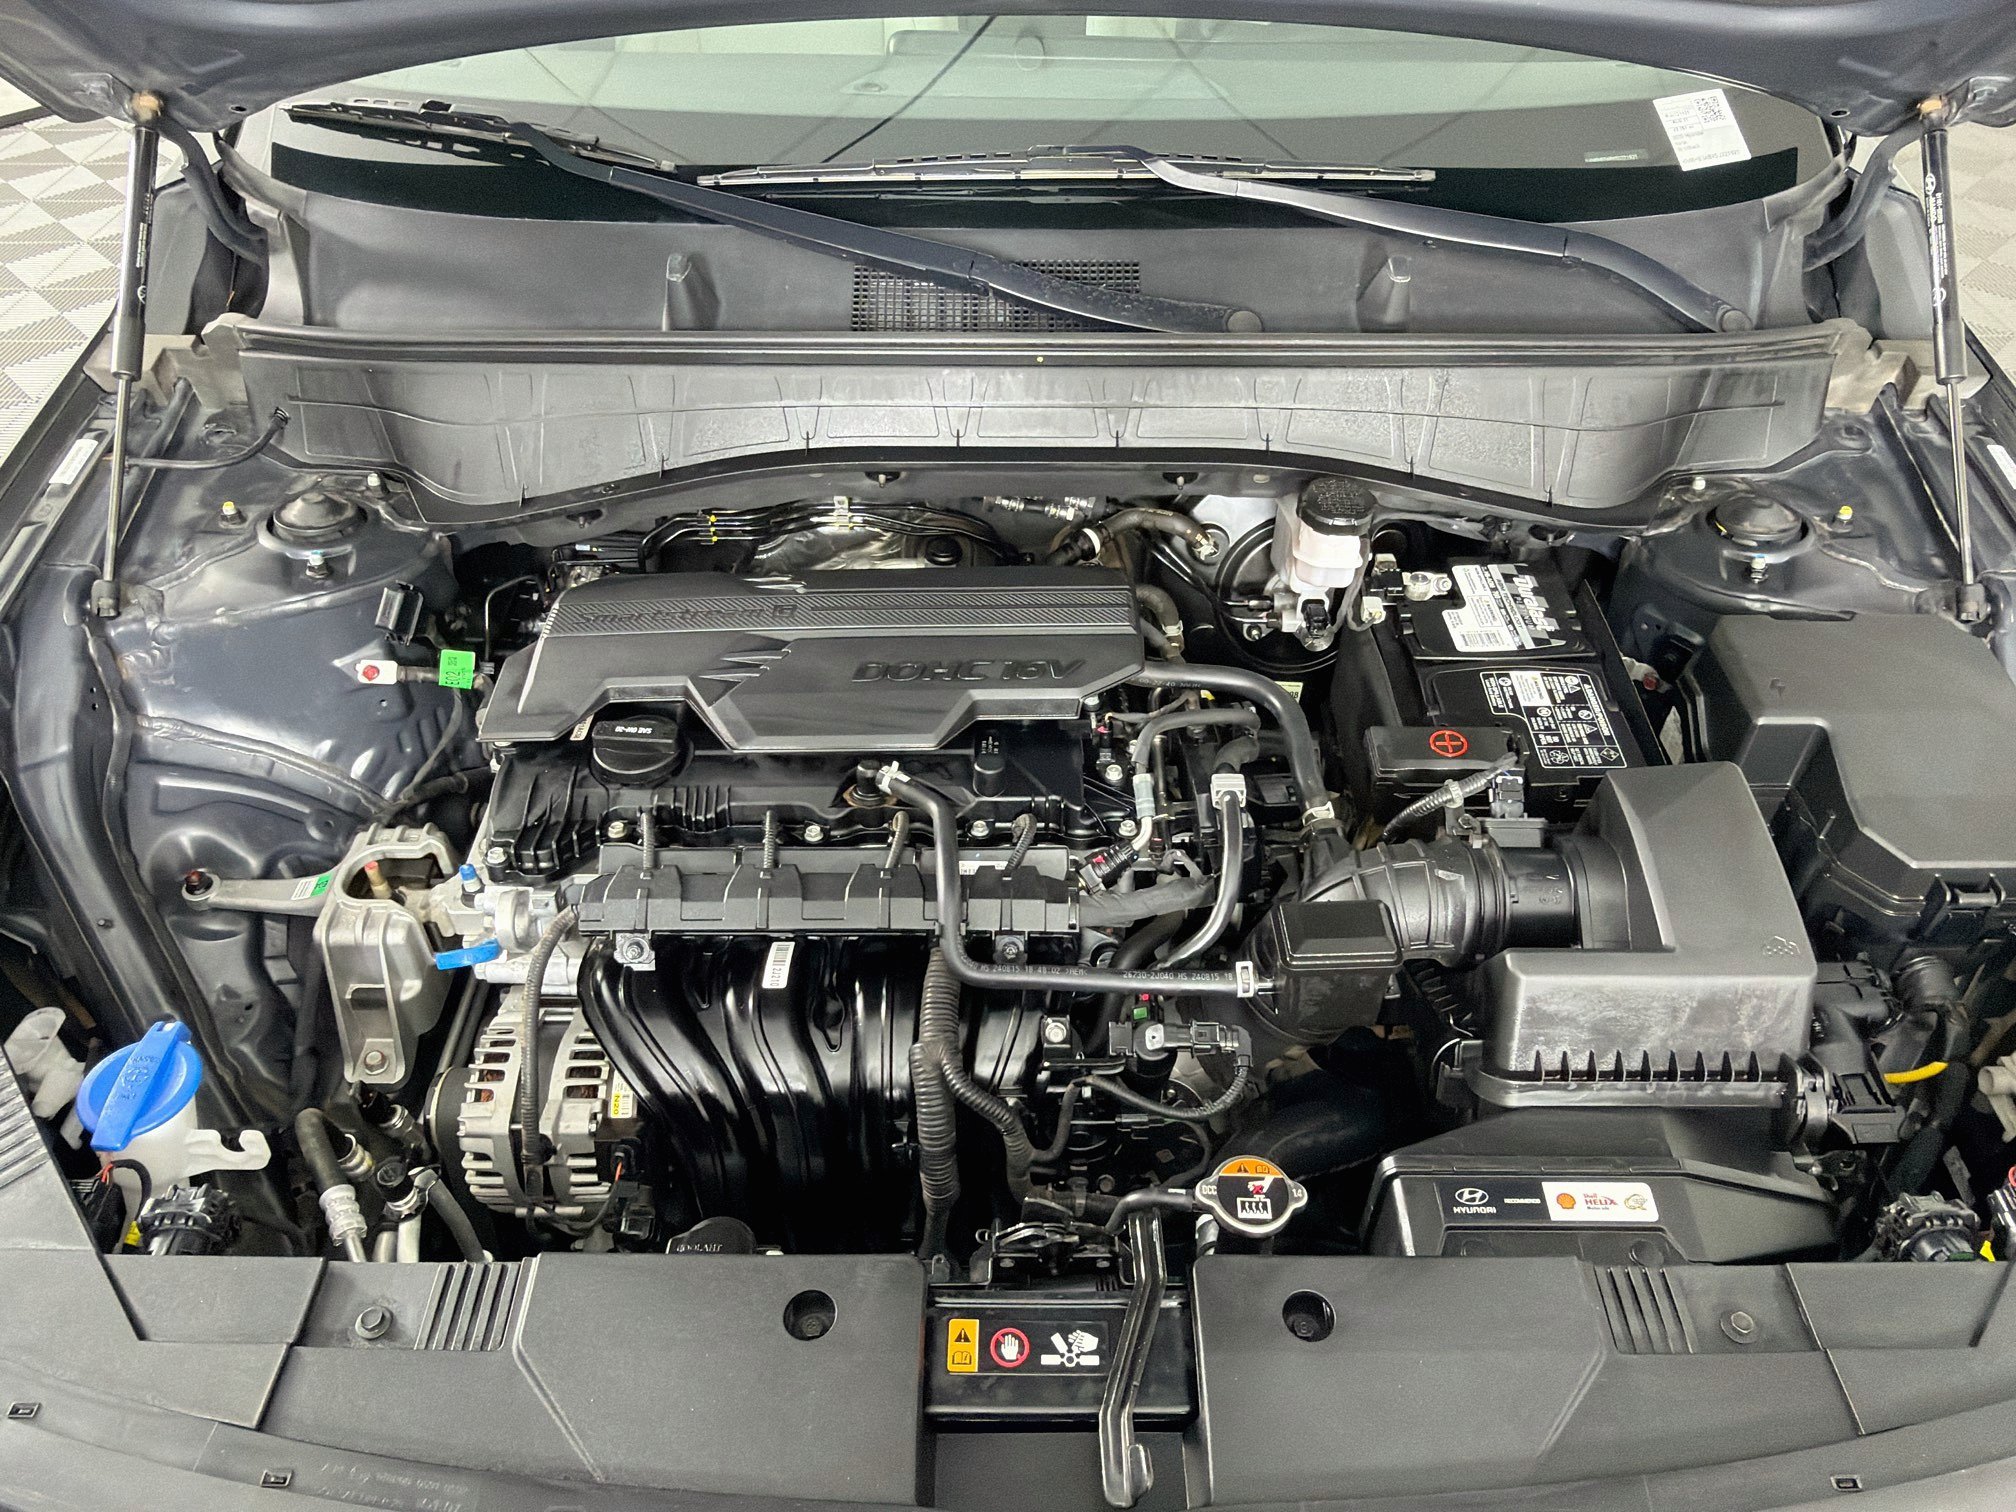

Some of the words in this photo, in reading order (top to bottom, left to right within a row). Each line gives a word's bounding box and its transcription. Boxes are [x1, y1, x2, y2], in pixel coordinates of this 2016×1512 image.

[1503, 592, 1524, 630] TECHNOLOGY
[1513, 575, 1555, 631] Duralast
[1514, 596, 1536, 631] PLATINUM
[851, 659, 996, 683] DOHC
[1002, 658, 1088, 682] 16V
[638, 726, 653, 734] SAE
[770, 967, 782, 987] 2J210
[1453, 1206, 1497, 1214] HYUNDAI
[1585, 1196, 1618, 1206] HELIX
